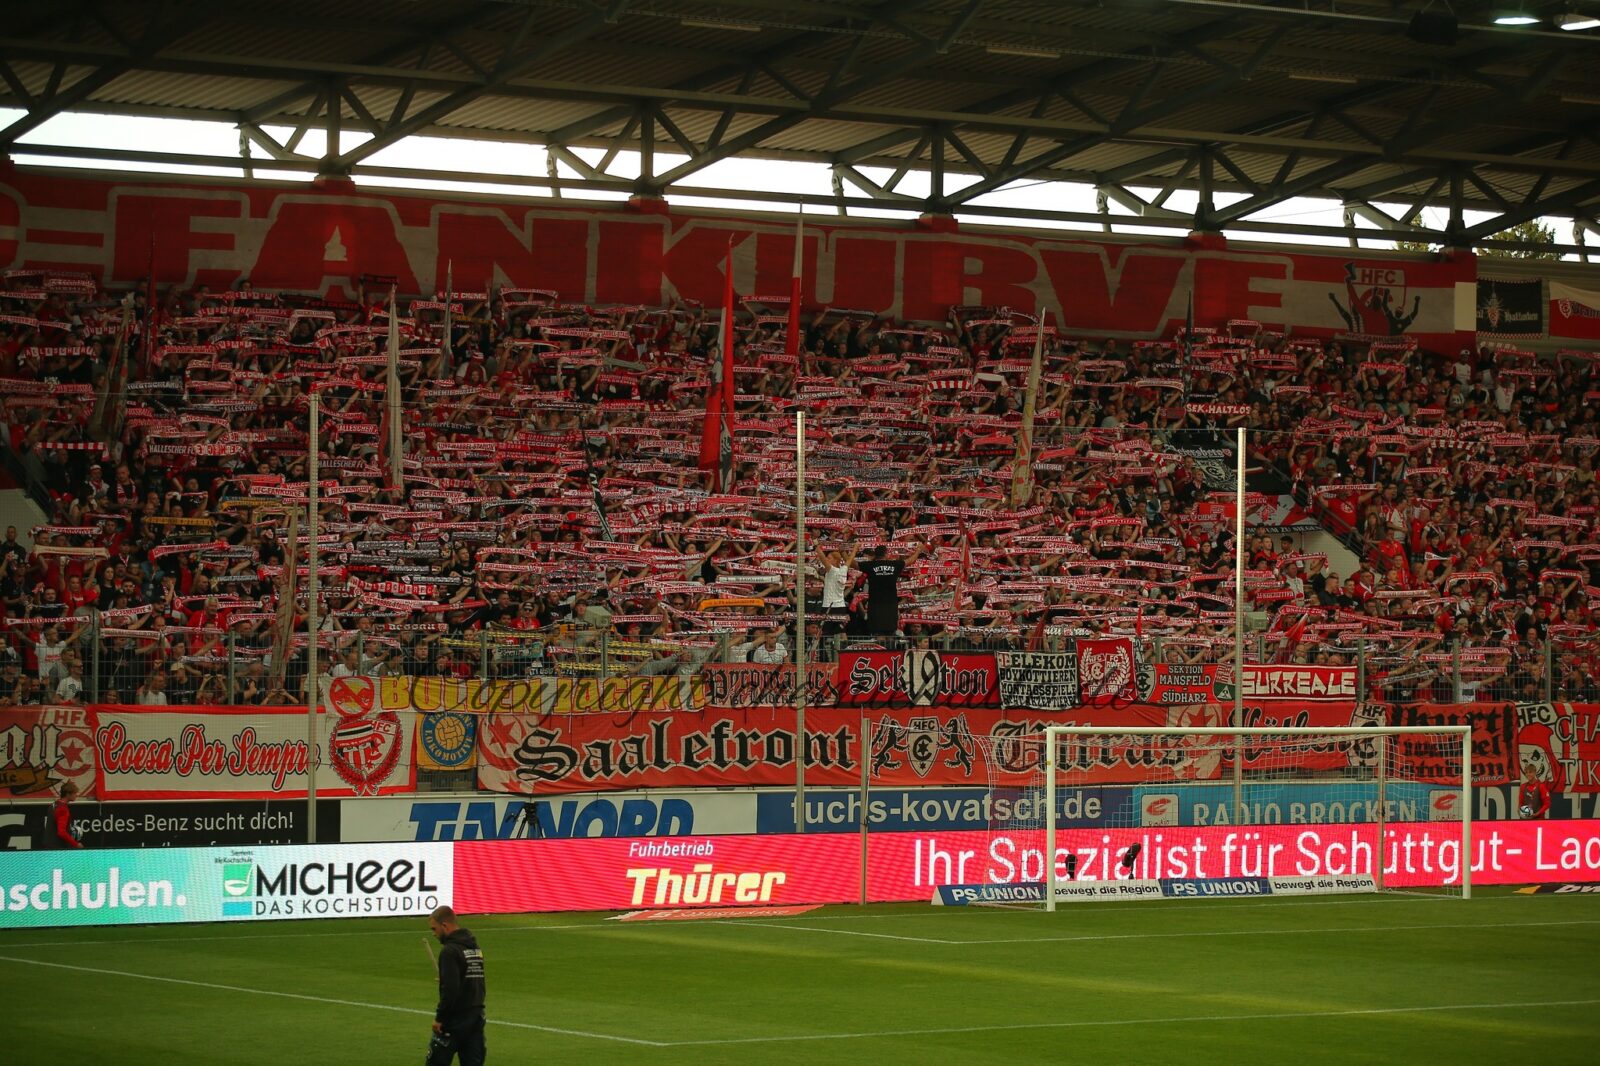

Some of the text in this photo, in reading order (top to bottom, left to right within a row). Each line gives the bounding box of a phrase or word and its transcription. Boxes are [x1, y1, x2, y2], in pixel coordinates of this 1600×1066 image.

[1361, 269, 1397, 284] HFC
[998, 653, 1076, 669] TELEKOM
[999, 668, 1076, 682] BOYKOTTIEREN
[1168, 665, 1203, 675] SEKTION
[1159, 674, 1211, 687] MANSFELD
[1241, 671, 1356, 696] SURREALE
[1001, 681, 1076, 696] MONTAGSSPIELE
[1162, 688, 1208, 703] SÜDHARZ
[175, 723, 226, 777] Per
[512, 718, 858, 783] Saalefront
[73, 811, 295, 833] rcedes-Benz sucht dich!
[1193, 803, 1281, 826] RADIO
[629, 841, 713, 857] Fuhrbetrieb
[913, 839, 974, 887] Ihr
[988, 834, 1207, 884] Spezialist
[1222, 832, 1284, 878] für
[0, 869, 187, 912] schulen.
[1099, 886, 1117, 895] die
[1119, 884, 1160, 897] Region
[1171, 880, 1261, 895] PS UNION
[1274, 877, 1374, 892] bewegt die Region
[952, 886, 1042, 901] PS UNION
[256, 895, 438, 915] DAS KOCHSTUDIO
